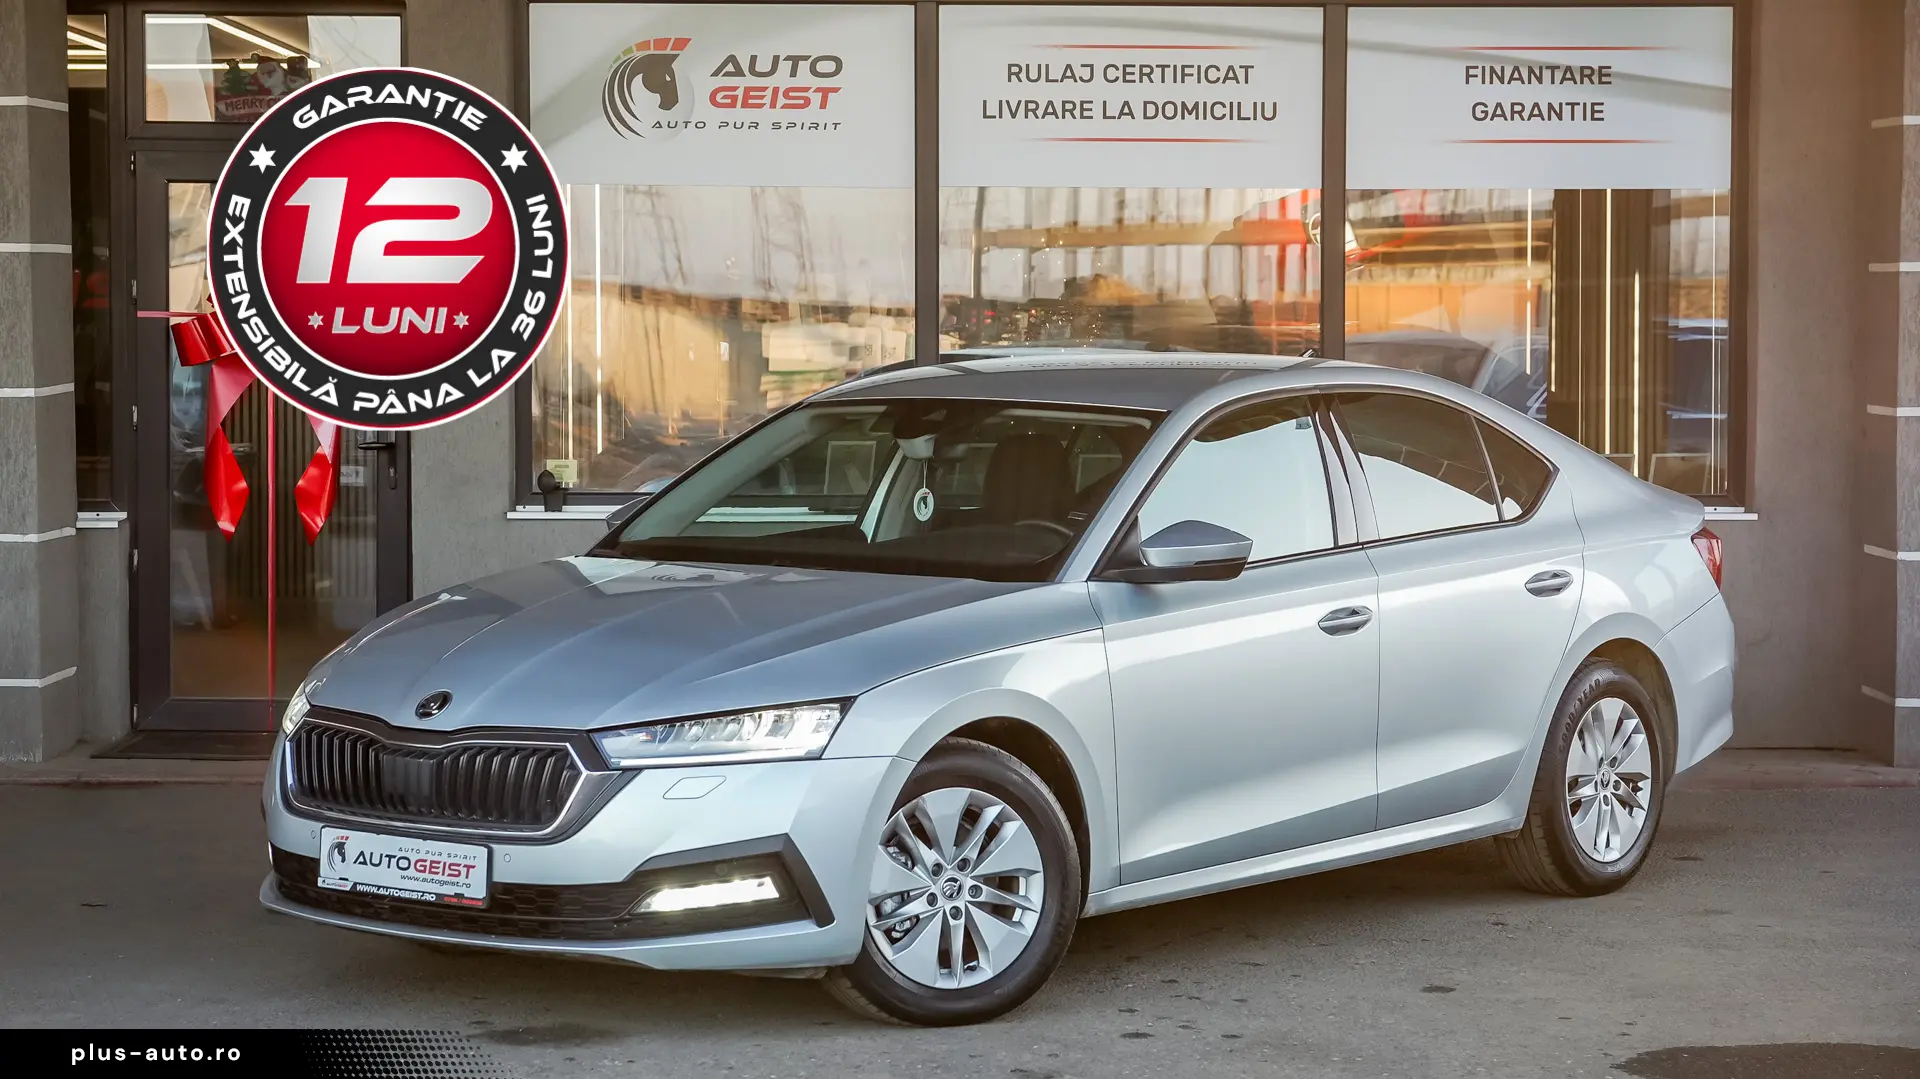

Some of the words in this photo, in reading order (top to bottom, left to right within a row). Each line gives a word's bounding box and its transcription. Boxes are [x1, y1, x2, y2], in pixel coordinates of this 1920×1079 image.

[709, 53, 844, 79] AUTO
[1006, 63, 1095, 83] RULAJ
[1102, 63, 1255, 85] CERTIFICAT
[1465, 65, 1612, 85] FINANTARE
[223, 97, 265, 112] MERRY
[708, 85, 843, 110] GEIST
[981, 99, 1094, 120] LIVRARE
[1102, 100, 1136, 120] LA
[1142, 100, 1278, 122] DOMICILIU
[1471, 101, 1605, 122] GARANTIE
[651, 120, 707, 130] AUTO
[717, 121, 760, 131] PUR
[771, 121, 842, 131] SPIRIT
[397, 846, 421, 855] AUTO
[424, 849, 443, 857] PUR
[446, 852, 478, 861] SPIRIT
[400, 874, 472, 889] www.autogeist.ro
[356, 883, 437, 901] WWW.AUTOGEIST.RO
